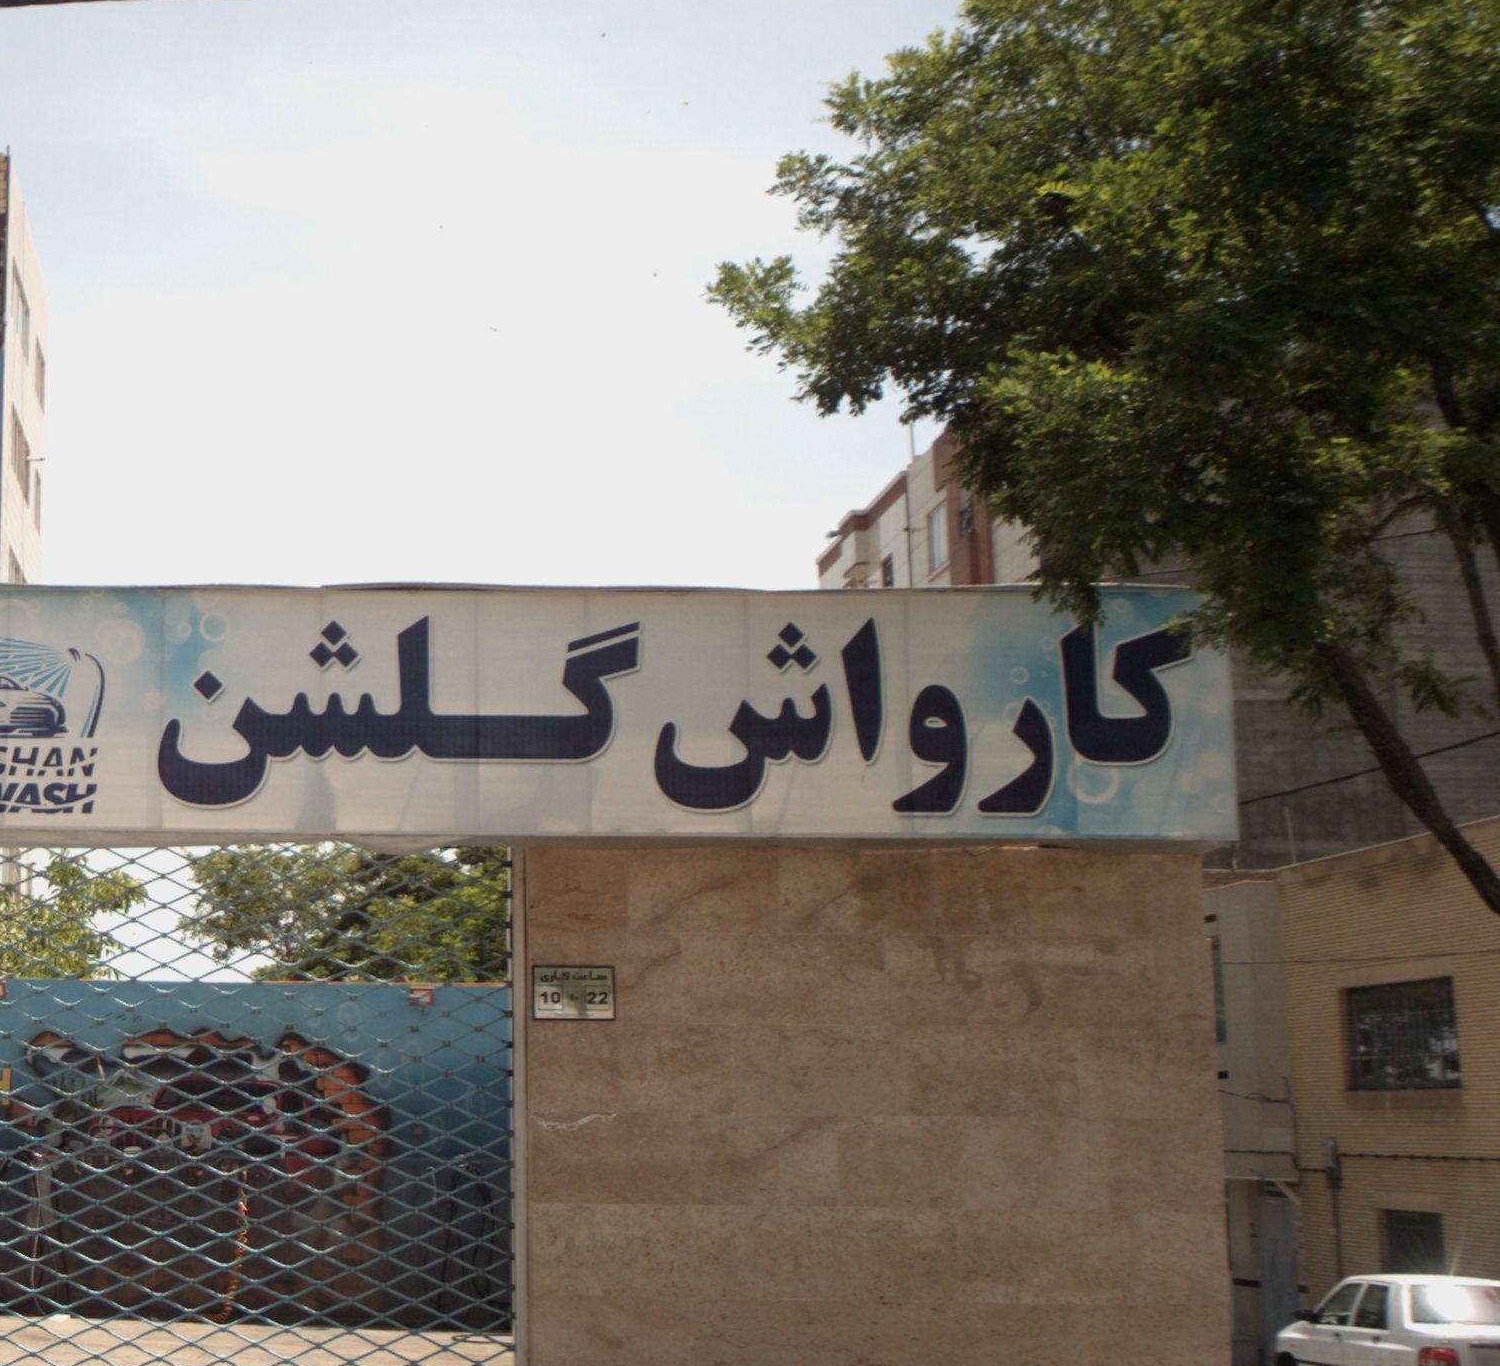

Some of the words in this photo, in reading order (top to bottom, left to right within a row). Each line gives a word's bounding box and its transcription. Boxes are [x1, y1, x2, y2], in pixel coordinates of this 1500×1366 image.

[159, 616, 640, 805] گلشن
[655, 617, 1193, 814] کارواش
[541, 991, 561, 1005] 10
[587, 991, 609, 1005] 22
